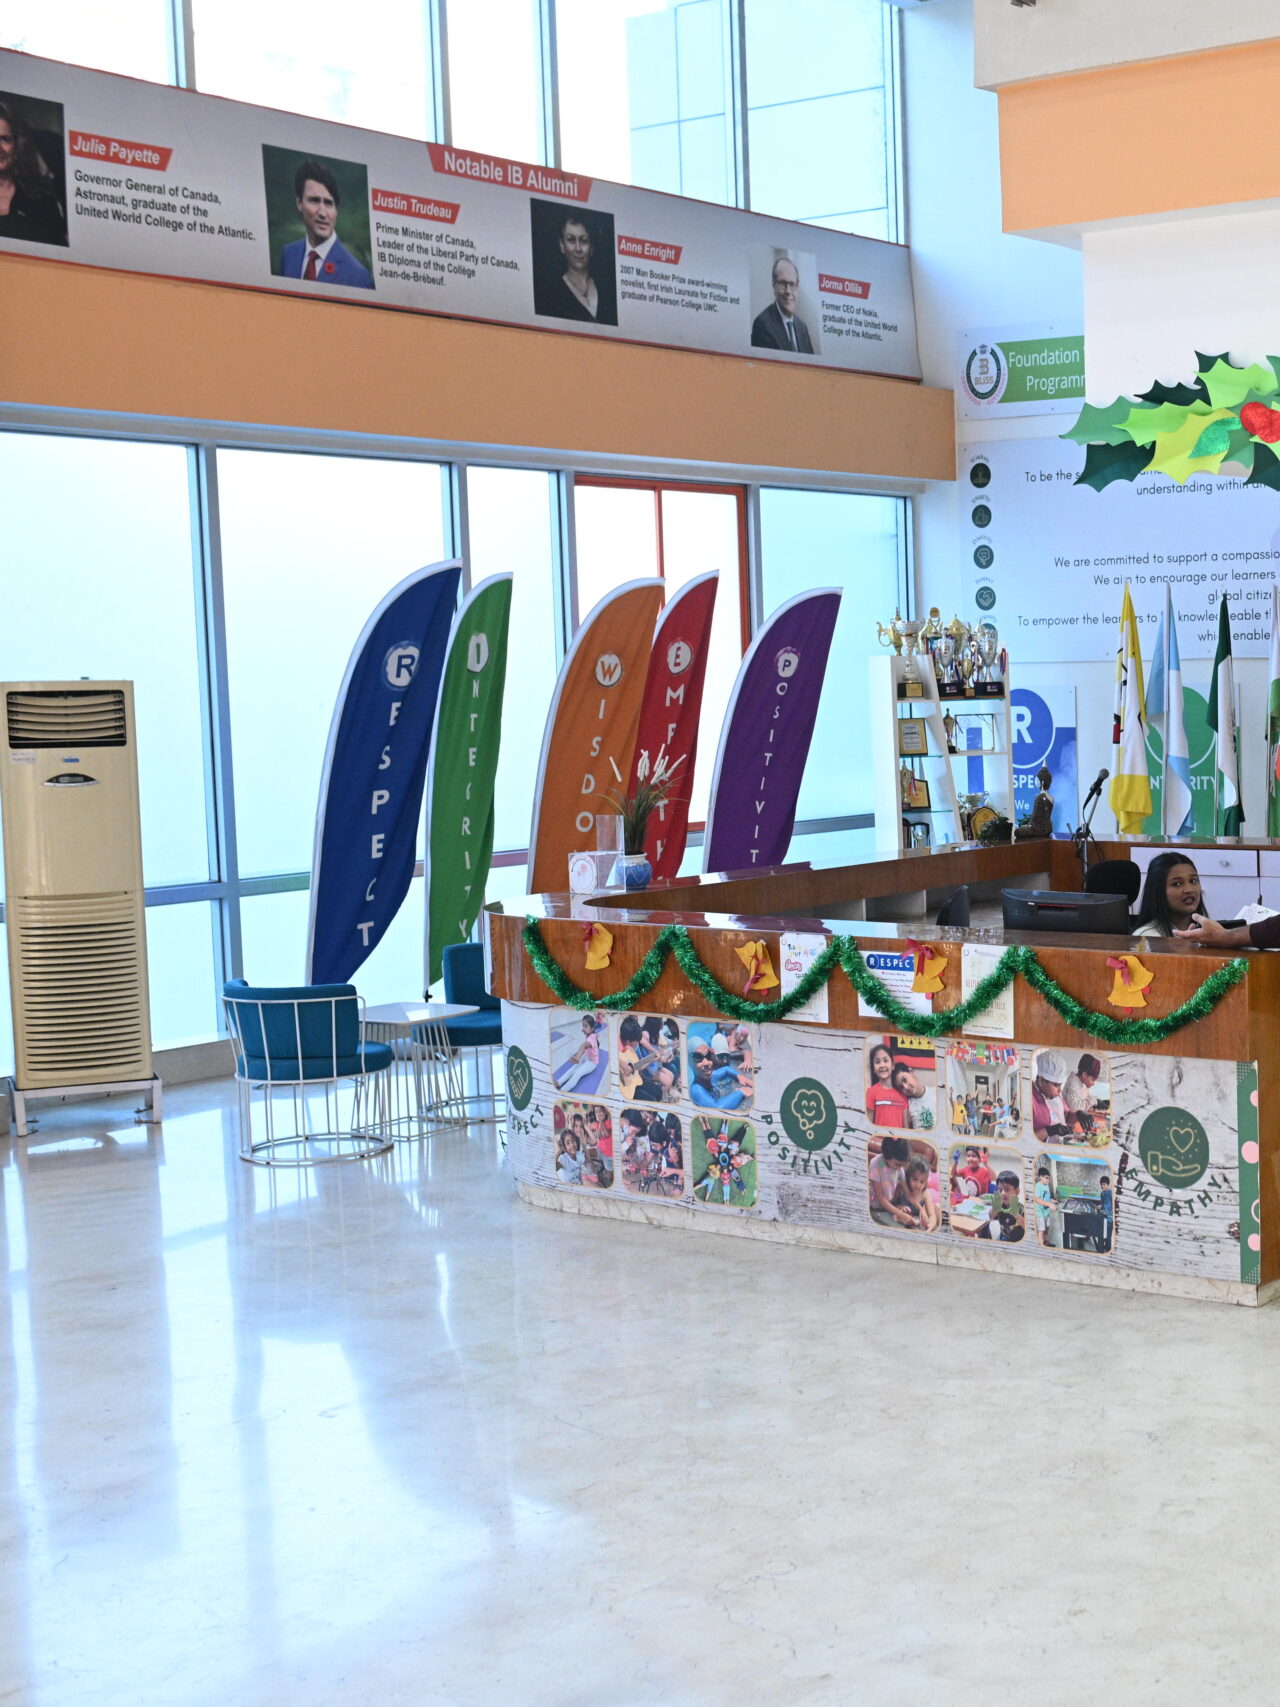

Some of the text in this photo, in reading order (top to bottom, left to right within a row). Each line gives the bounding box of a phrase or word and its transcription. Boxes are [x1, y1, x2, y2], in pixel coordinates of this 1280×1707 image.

[73, 136, 160, 165] Julie Payette
[444, 151, 578, 197] Notable IB Alumni
[75, 170, 222, 205] Governor General of Canada,
[75, 187, 208, 218] Astronaut, graduate of the
[374, 193, 452, 218] Justin Trudeau
[75, 204, 256, 241] United World College of the Atlantic.
[376, 222, 476, 250] Prime Minister of Canada,
[377, 237, 520, 272] Leader of the Liberal Party of Canada,
[620, 239, 675, 260] Anne Enright
[378, 252, 386, 263] IB
[389, 253, 421, 269] Diploma
[424, 261, 431, 270] of
[433, 261, 445, 272] the
[620, 265, 634, 275] 2007
[636, 268, 648, 278] Man
[650, 270, 670, 281] Booker
[672, 274, 686, 284] Prize
[820, 276, 843, 291] Jorma
[621, 290, 647, 301] graduate
[656, 295, 680, 307] Pearson
[700, 291, 708, 300] for
[709, 292, 728, 304] Fiction
[729, 297, 740, 305] and
[821, 300, 841, 311] Former
[842, 304, 855, 313] CEO
[823, 324, 844, 337] College
[863, 319, 881, 330] United
[1008, 347, 1080, 368] Foundation
[1025, 471, 1037, 482] To
[1040, 470, 1053, 482] be
[1056, 469, 1073, 480] the
[1137, 478, 1213, 495] understanding
[1216, 477, 1249, 491] within
[1054, 557, 1070, 567] We
[1073, 558, 1090, 567] are
[1094, 553, 1149, 566] committed
[1153, 554, 1164, 564] to
[1167, 552, 1207, 566] support
[1211, 553, 1218, 561] a
[1094, 575, 1110, 585] We
[1136, 574, 1146, 584] to
[1150, 573, 1207, 585] encourage
[1211, 572, 1228, 581] our
[1231, 569, 1275, 580] learners
[1018, 616, 1029, 626] To
[1032, 616, 1079, 628] empower
[1083, 613, 1099, 624] the
[1147, 613, 1158, 623] to
[1233, 629, 1270, 640] enable
[869, 957, 914, 969] RESPEC
[761, 1114, 856, 1175] POSITIVITY
[1125, 1168, 1222, 1217] EMPATHY
